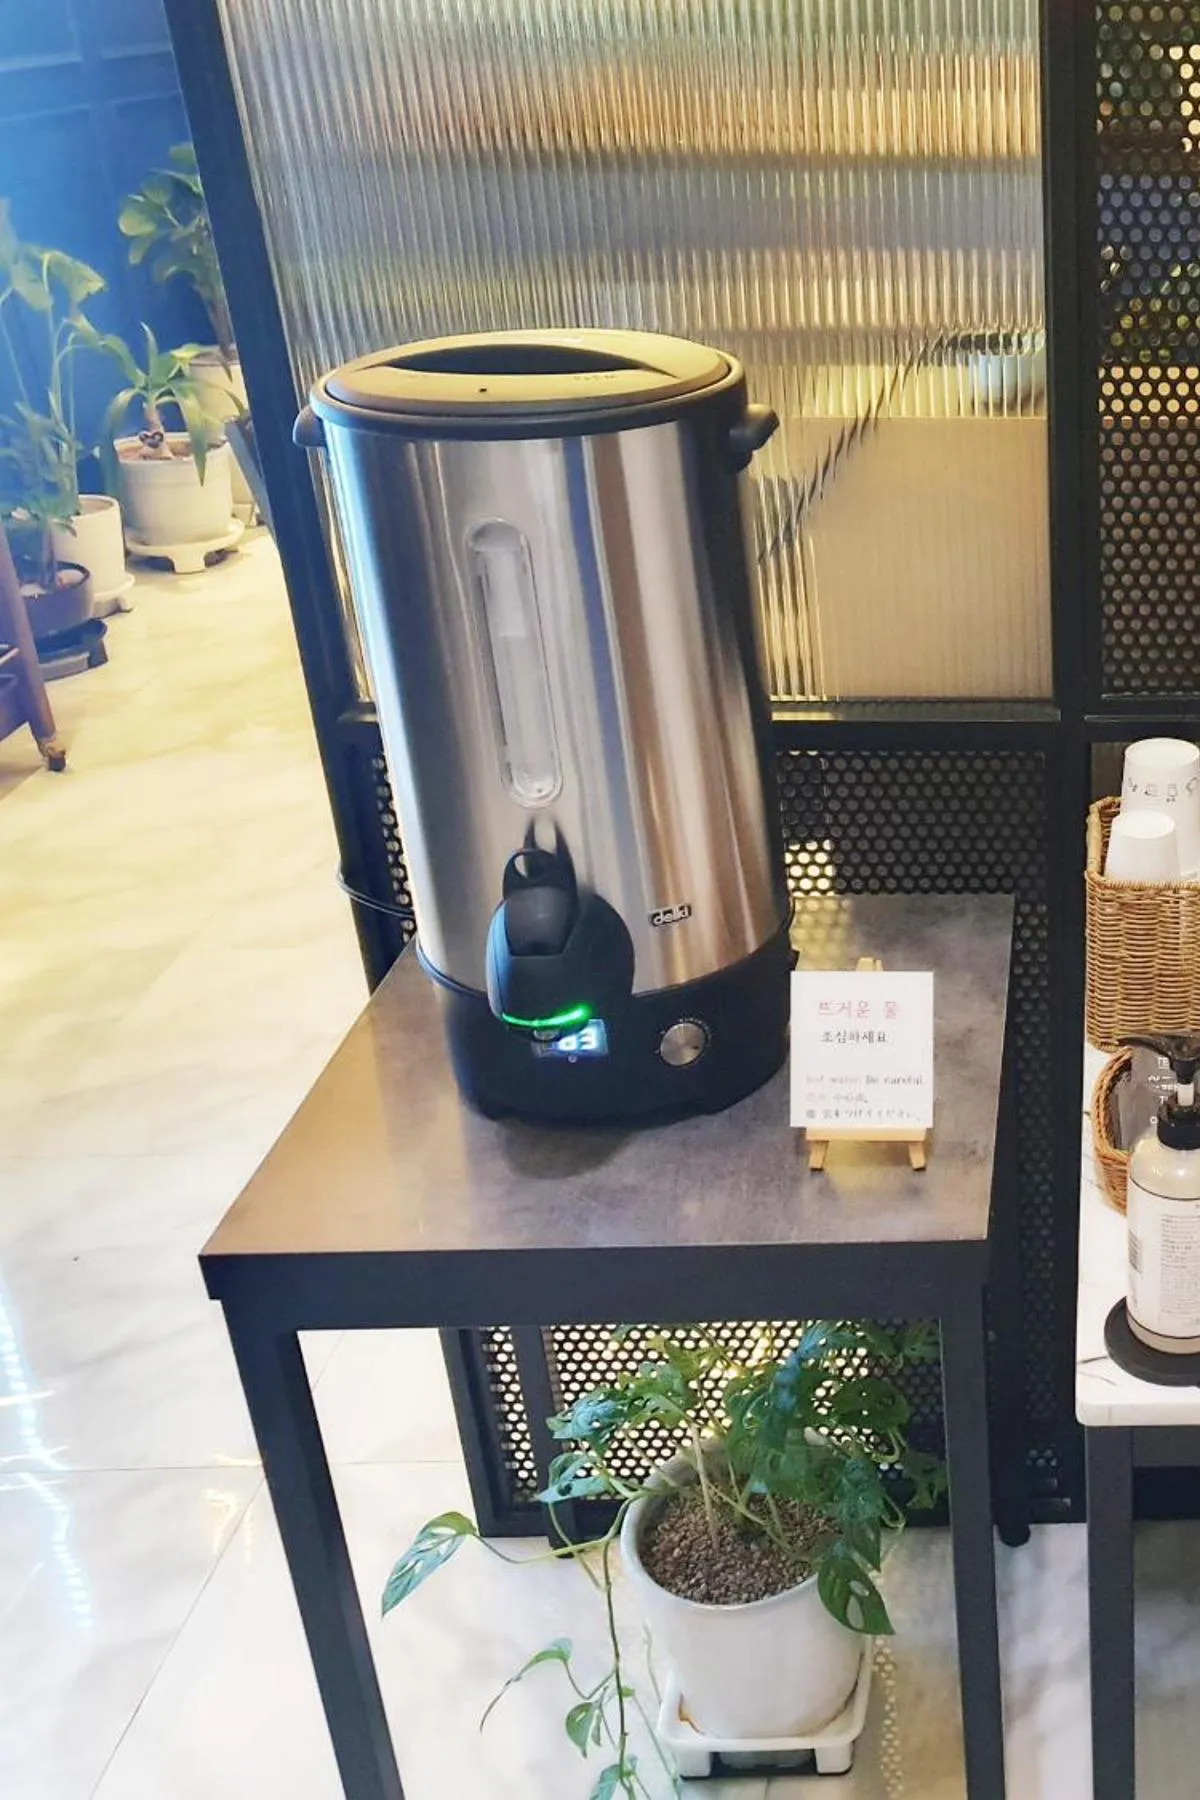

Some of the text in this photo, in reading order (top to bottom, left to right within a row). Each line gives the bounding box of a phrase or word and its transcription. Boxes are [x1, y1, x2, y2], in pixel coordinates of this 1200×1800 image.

[819, 1001, 899, 1019] 뜨거운 물
[821, 1030, 887, 1044] 조심하세요
